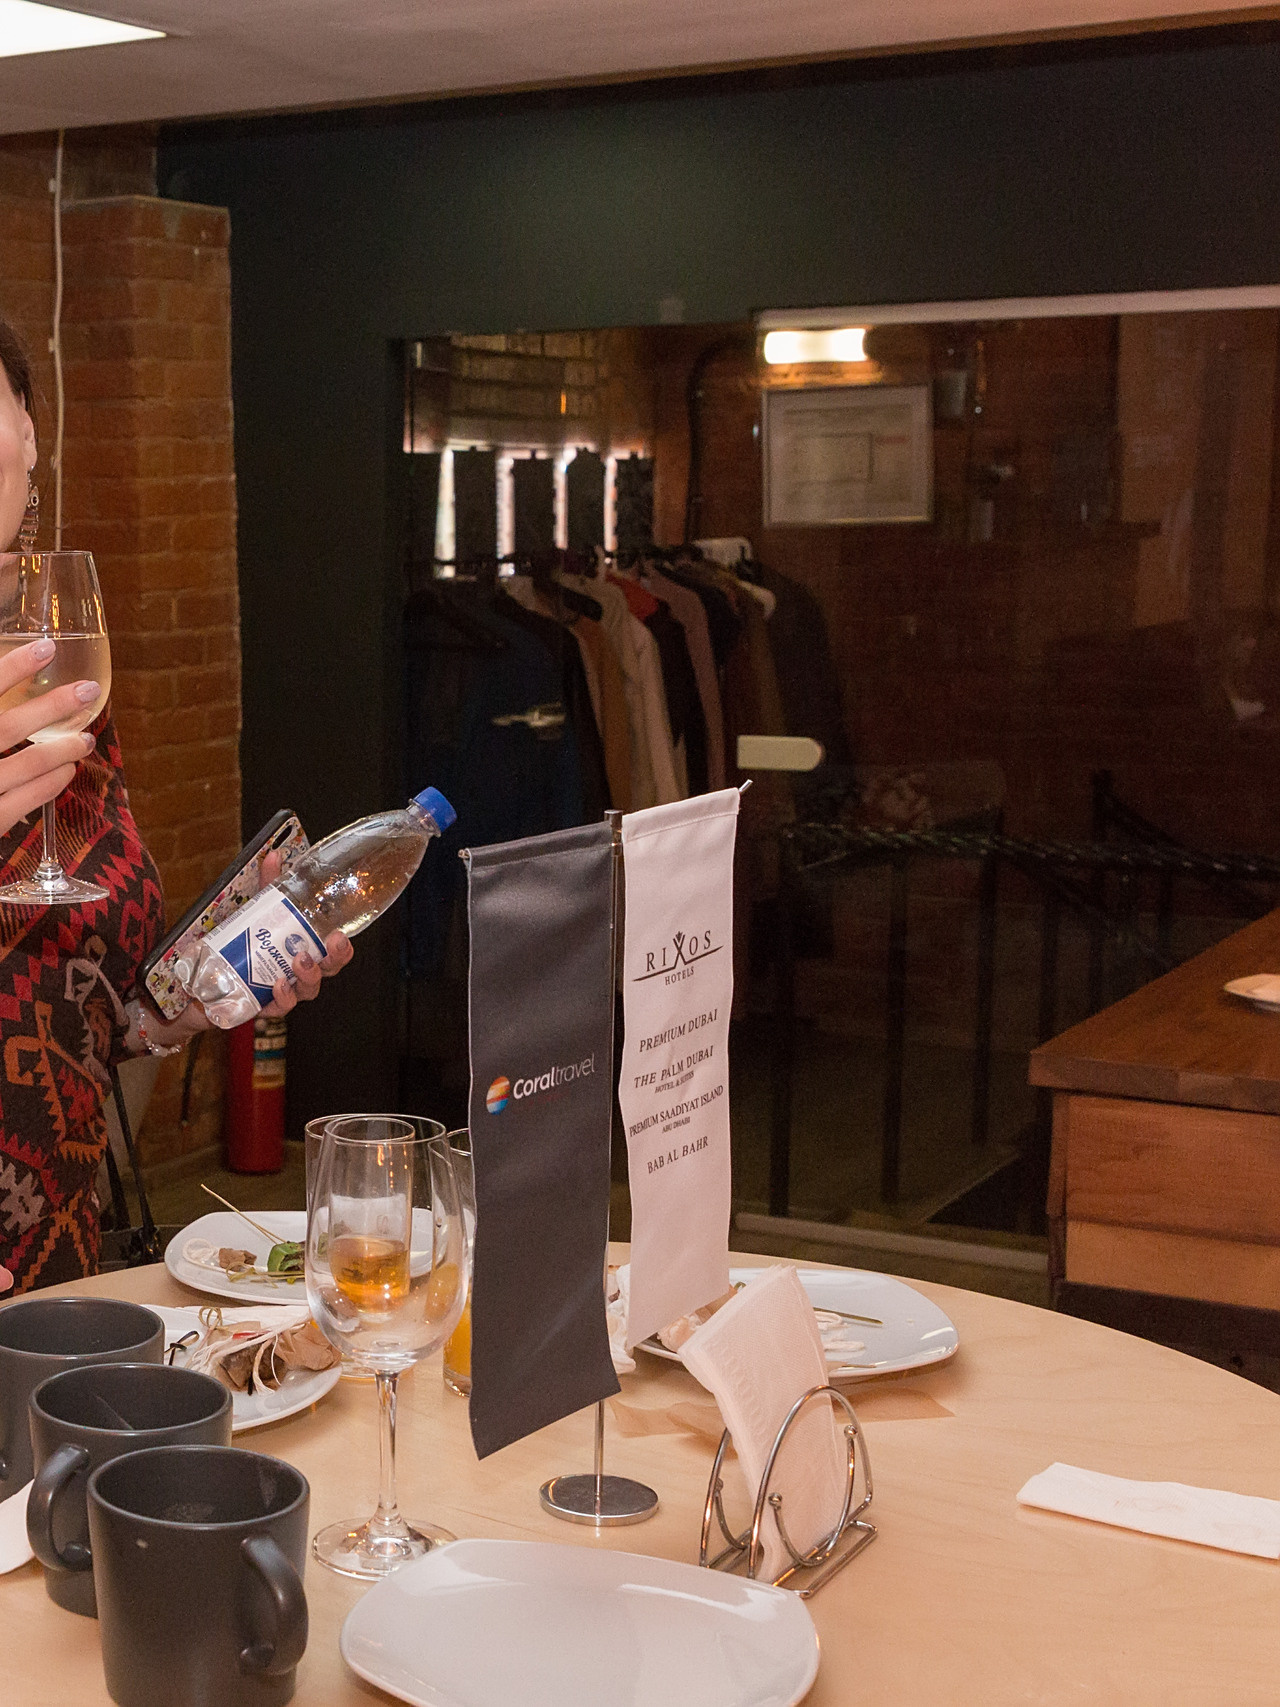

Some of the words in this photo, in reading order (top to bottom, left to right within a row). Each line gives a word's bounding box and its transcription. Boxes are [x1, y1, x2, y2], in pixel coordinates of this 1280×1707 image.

[646, 930, 711, 972] RIXOS
[664, 966, 695, 986] HOTELS
[639, 1023, 686, 1053] PREMIUM
[687, 1008, 718, 1033] DUBAI
[633, 1072, 657, 1089] THE
[660, 1059, 684, 1081] PALM
[686, 1045, 714, 1068] DUBAI
[654, 1081, 675, 1093] HOTEL
[628, 1113, 659, 1137] PREMIUM
[660, 1098, 699, 1122] SAADIYAT
[700, 1084, 724, 1107] ISLAND
[662, 1123, 673, 1133] ABU
[673, 1116, 690, 1129] DHABI
[647, 1155, 665, 1174] BAB
[666, 1149, 679, 1165] AL
[682, 1135, 709, 1157] BAHR
